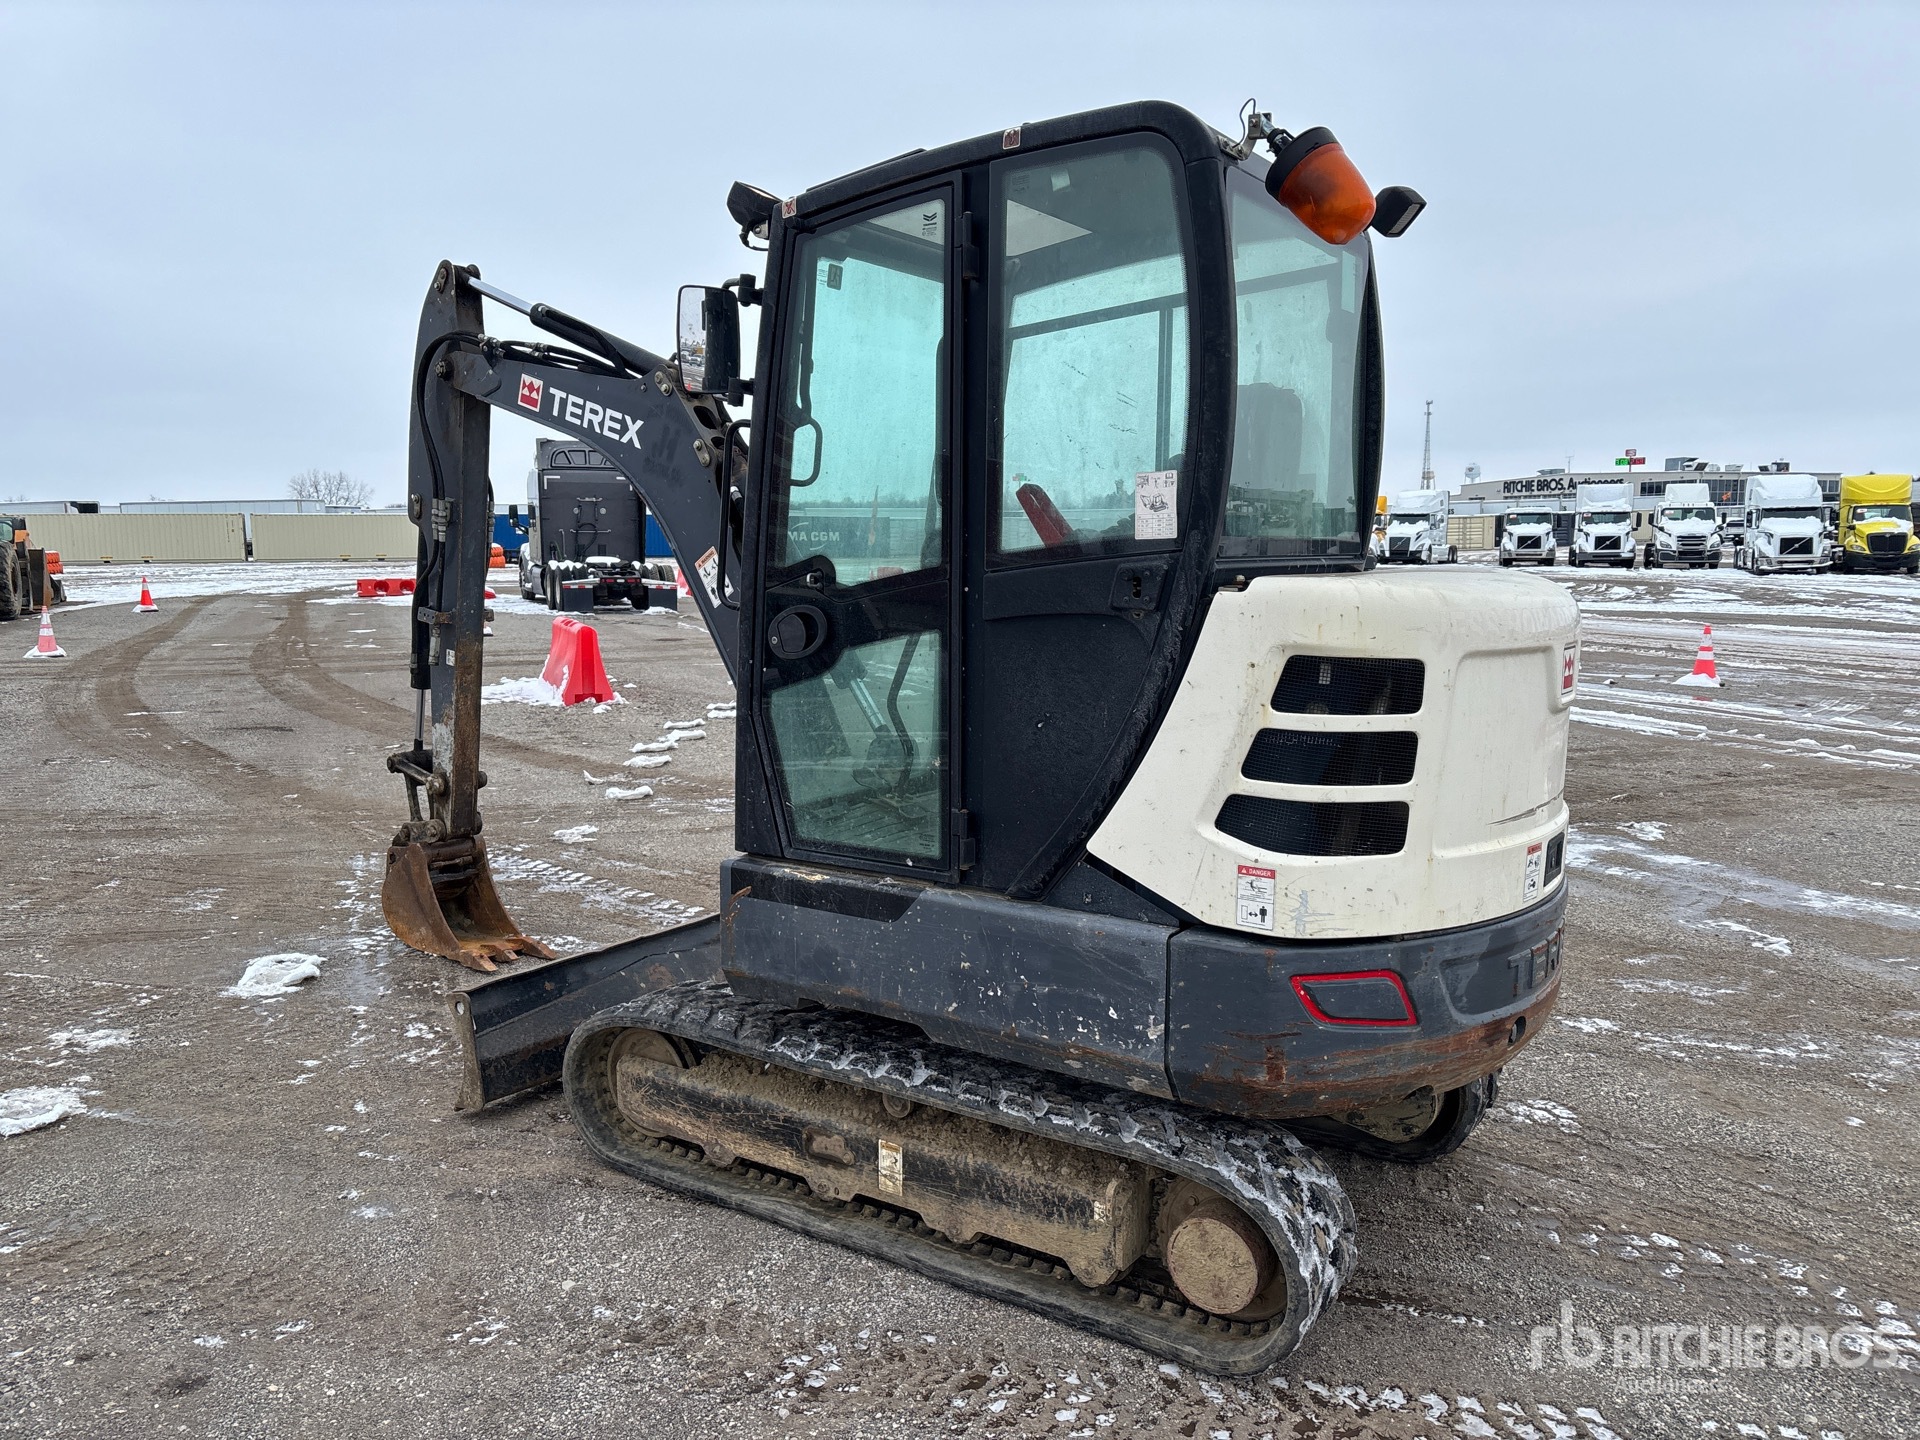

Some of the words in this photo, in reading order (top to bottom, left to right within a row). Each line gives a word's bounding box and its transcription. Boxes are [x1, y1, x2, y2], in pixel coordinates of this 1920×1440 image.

[549, 387, 644, 449] TEREX
[1503, 480, 1535, 493] RITCHIE
[1537, 477, 1566, 492] BROS.
[810, 531, 840, 542] CGM
[1248, 868, 1272, 877] DANGER
